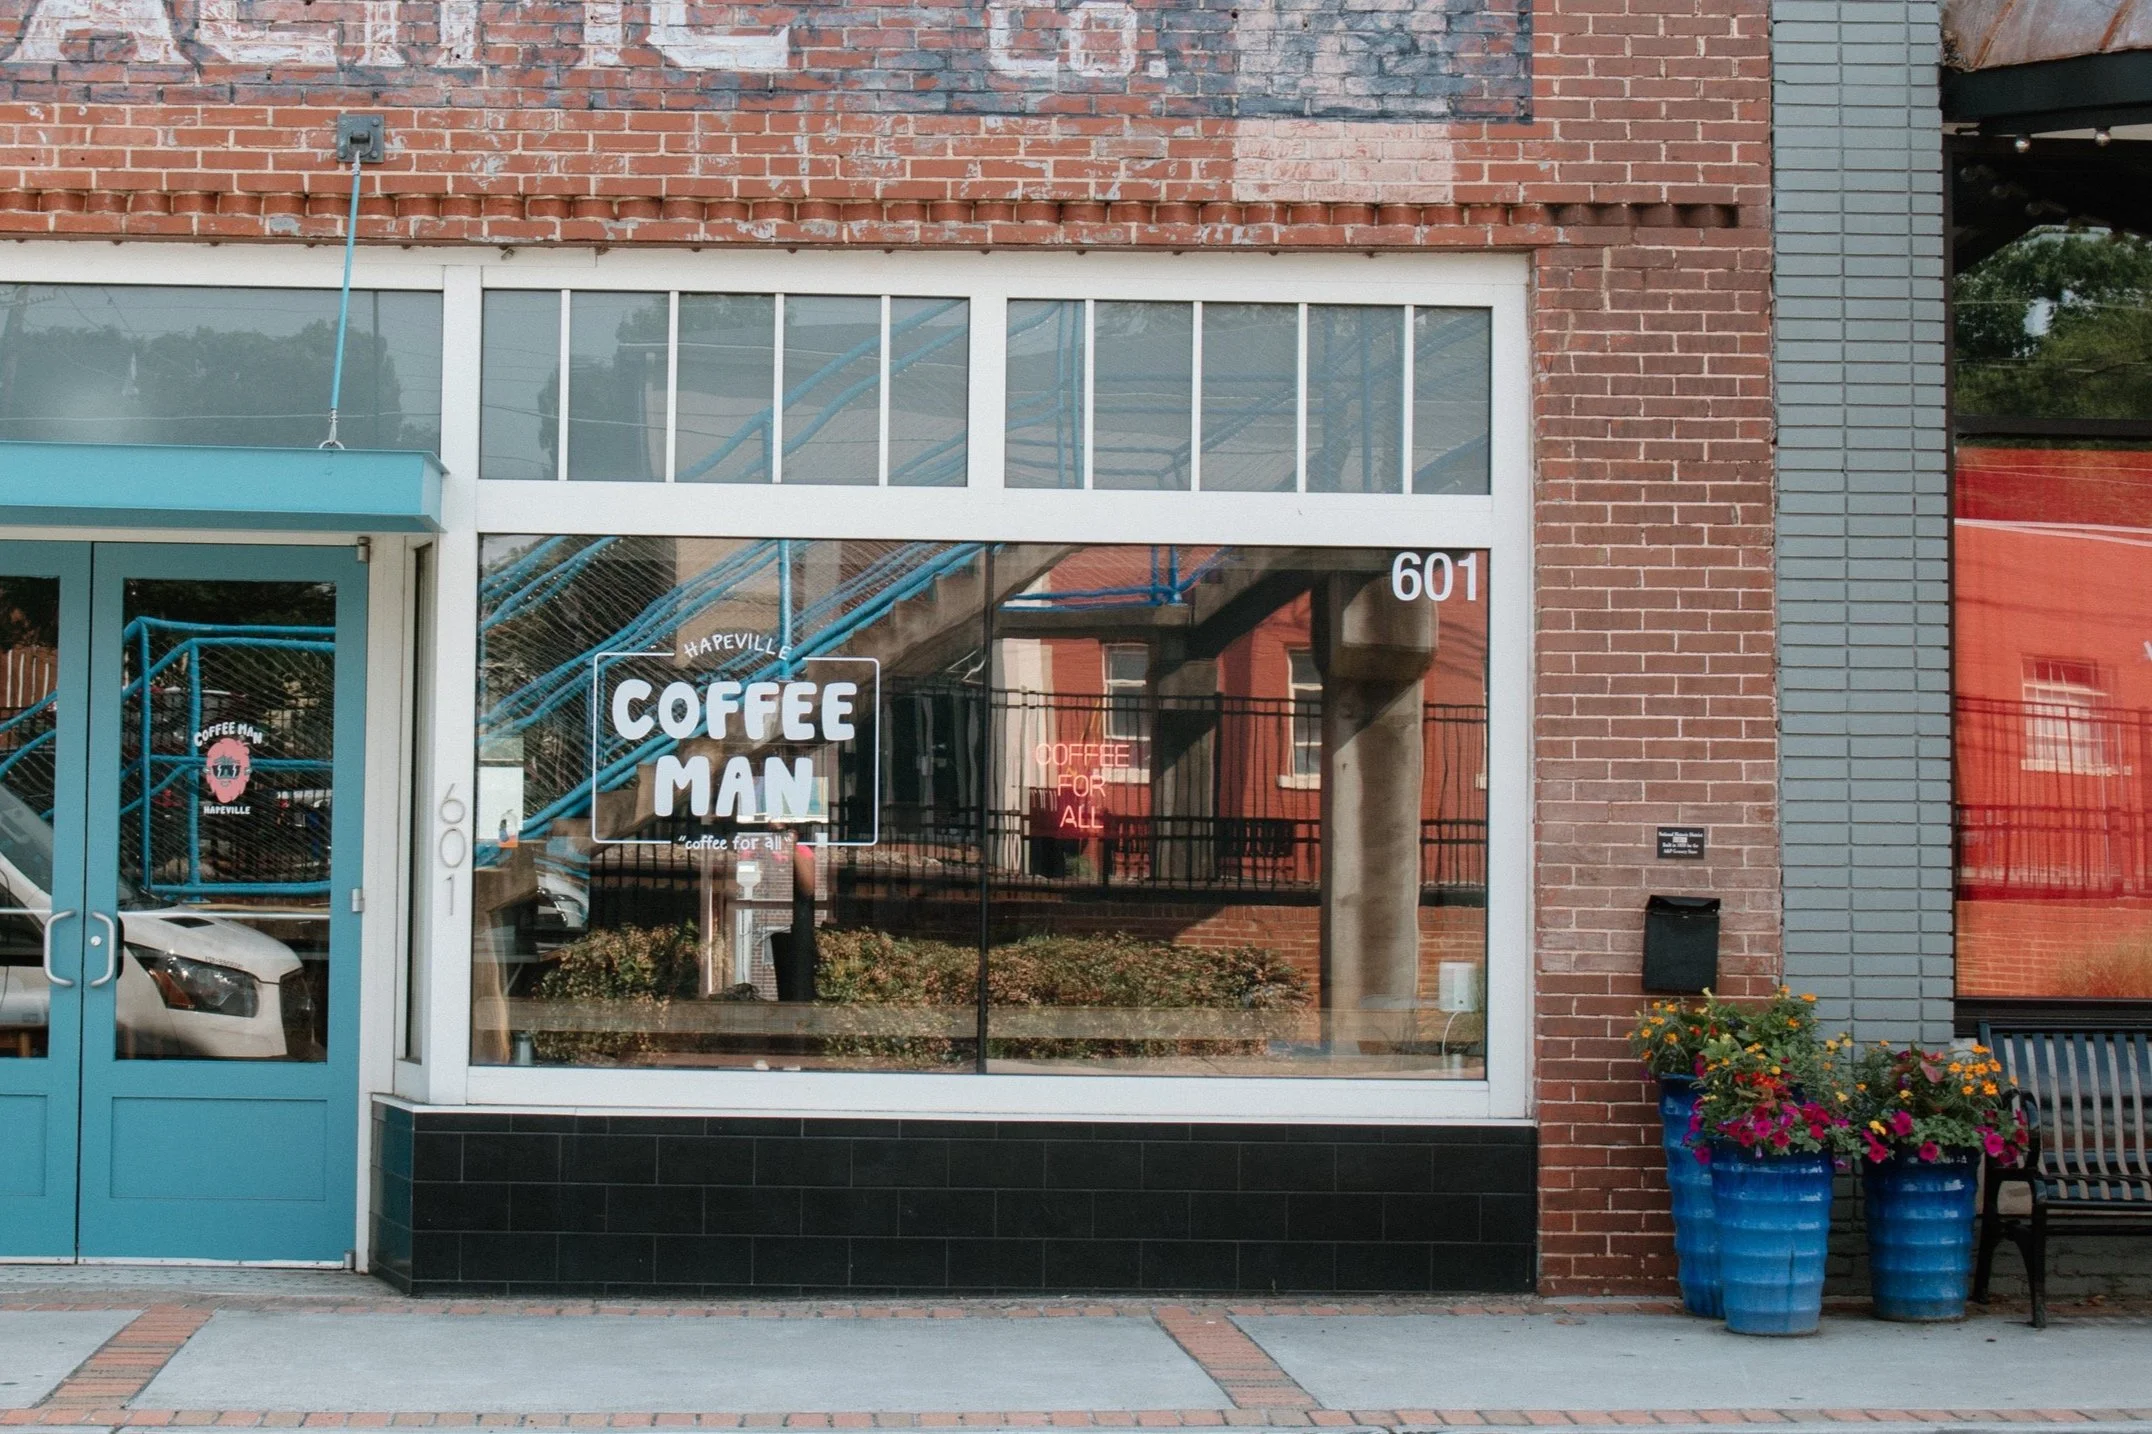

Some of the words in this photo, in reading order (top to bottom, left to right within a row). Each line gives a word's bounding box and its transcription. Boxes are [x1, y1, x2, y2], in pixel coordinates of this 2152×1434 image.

[1392, 551, 1477, 602] 601
[683, 632, 793, 661] HAPEVILLE
[612, 679, 857, 741] COFFEE
[193, 722, 236, 747] COFFEE
[237, 723, 263, 744] MAN
[1035, 743, 1130, 768] COFFEE
[654, 754, 813, 817] MAN
[1057, 774, 1106, 798] FOR
[203, 805, 251, 815] HAPEVILLE
[1060, 805, 1104, 829] ALL
[439, 783, 467, 916] 601
[732, 835, 759, 850] for
